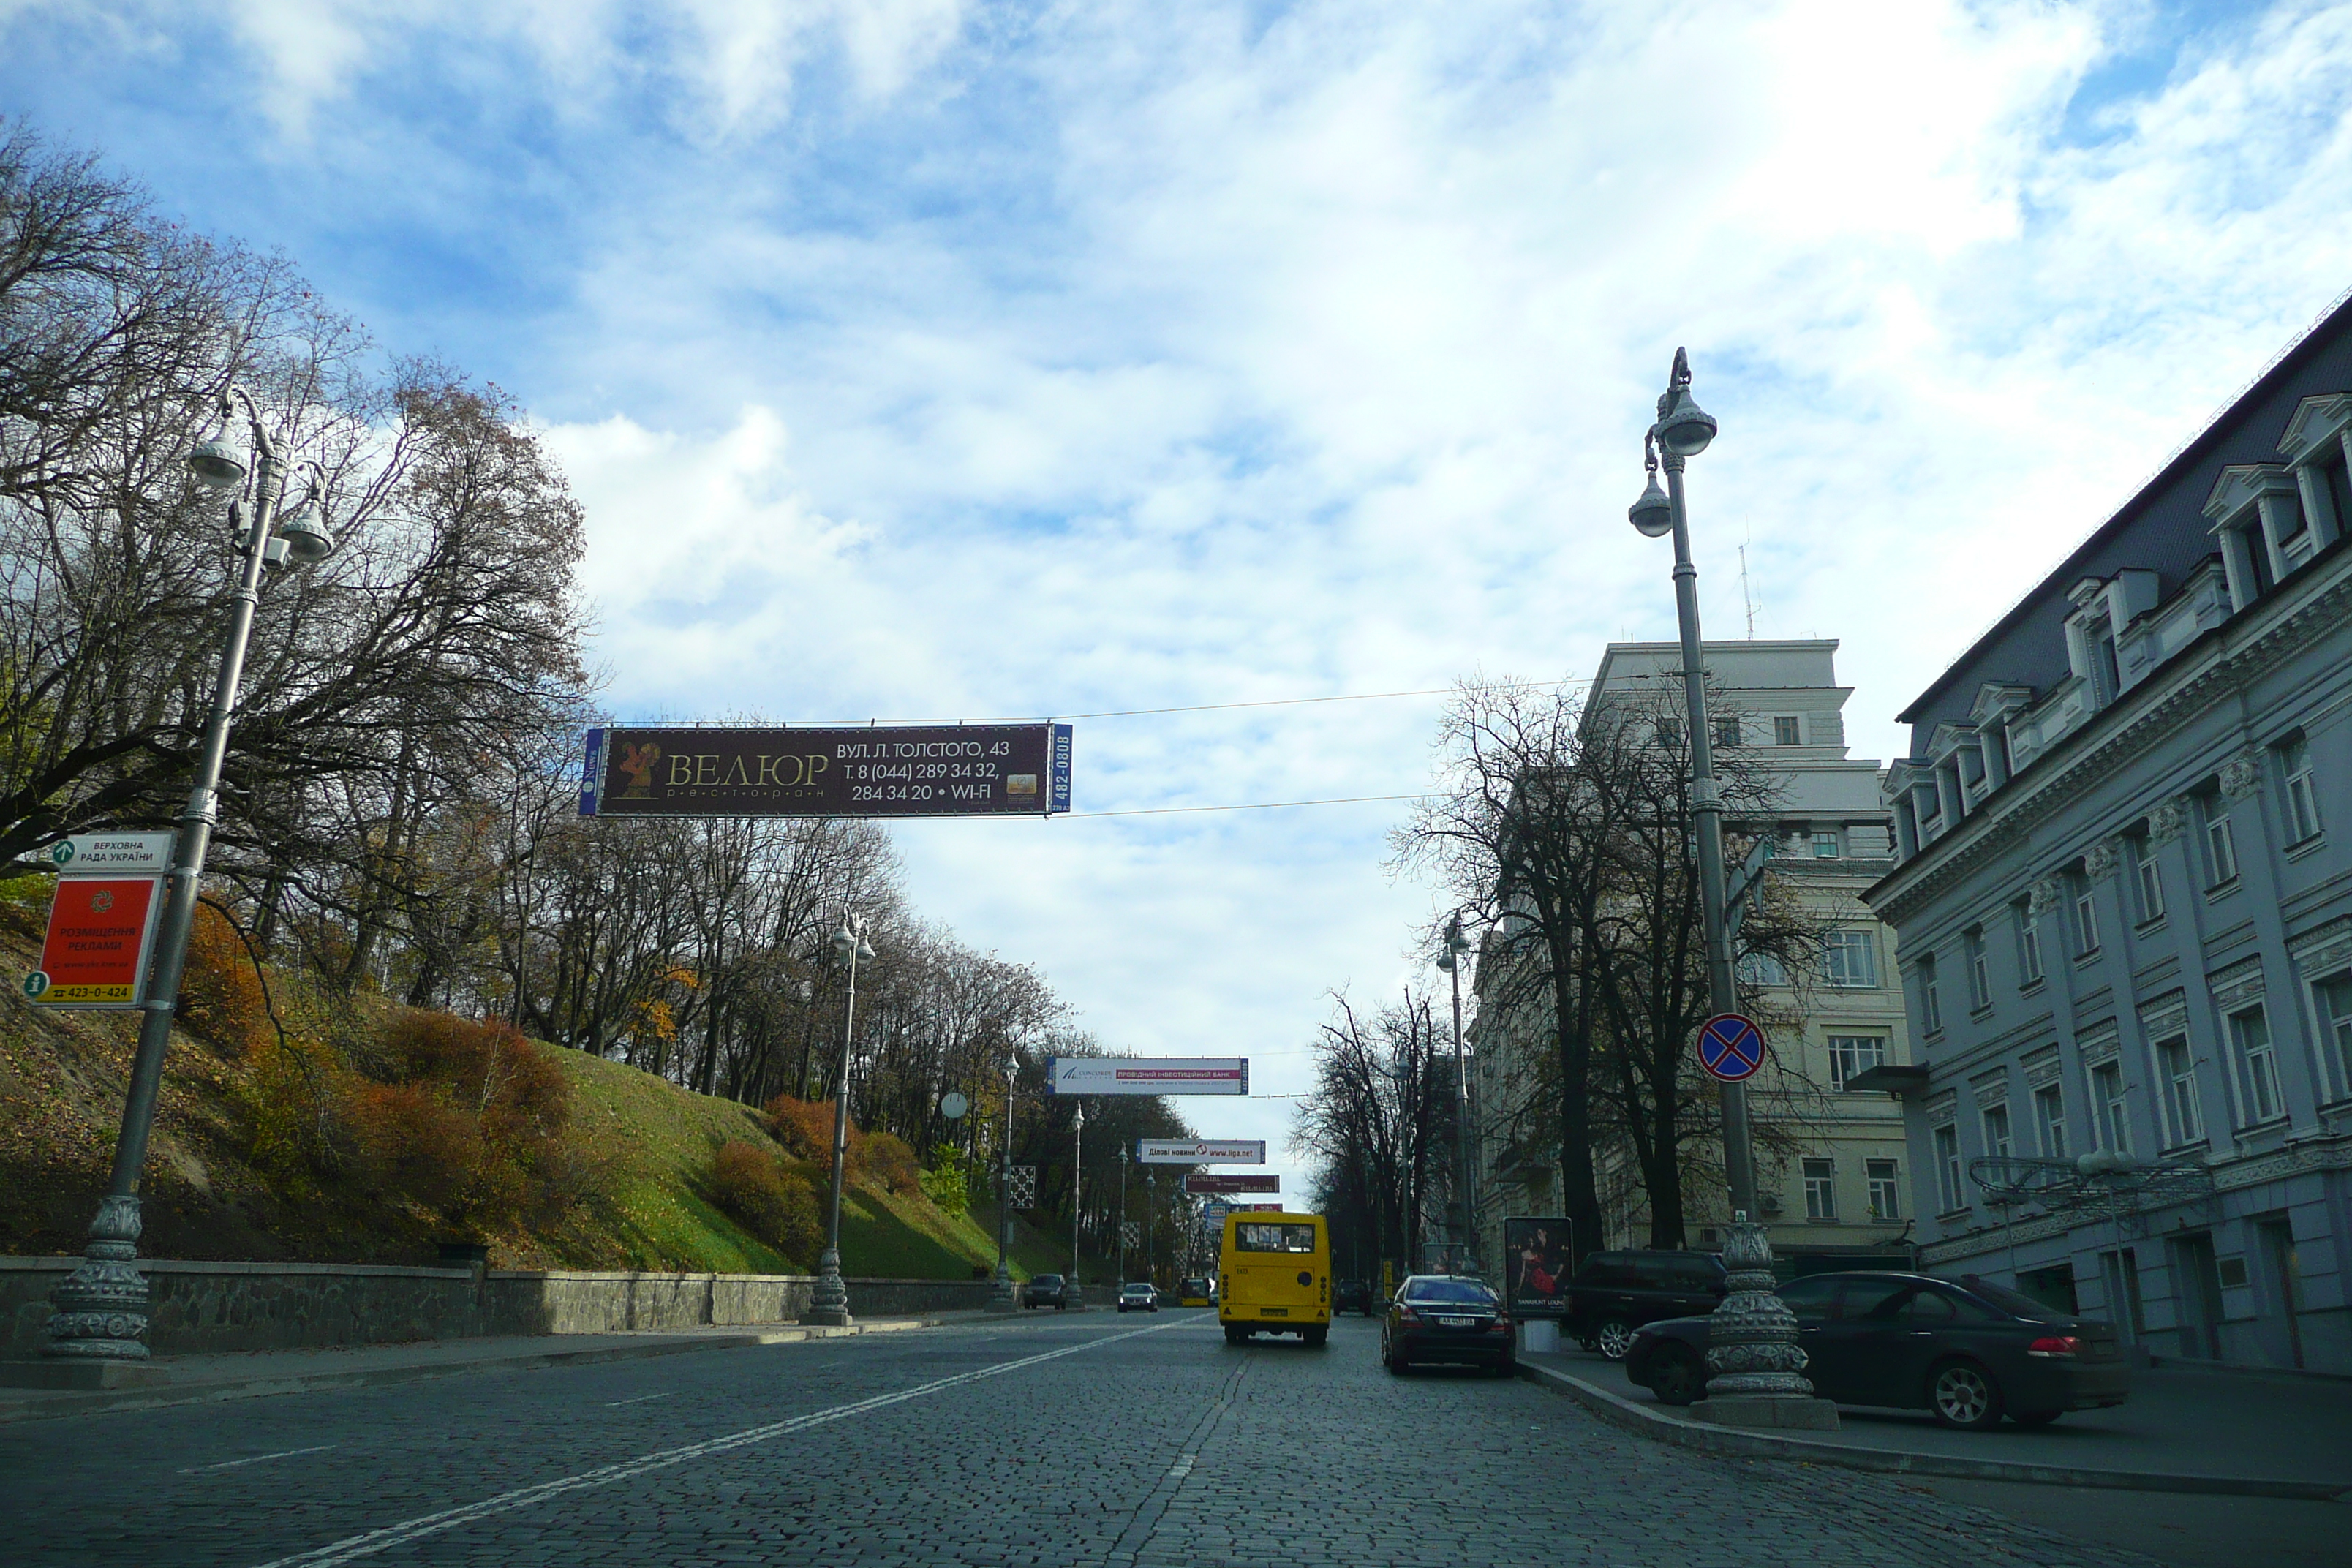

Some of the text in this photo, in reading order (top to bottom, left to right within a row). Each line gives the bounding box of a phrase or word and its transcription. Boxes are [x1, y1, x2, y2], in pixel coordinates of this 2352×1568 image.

[837, 741, 1009, 758] ВУЛ. Л. ТОЛСТОГО, 43
[665, 754, 829, 786] ВЕЛЮР
[858, 765, 868, 780] 8
[872, 763, 912, 783] (044)
[916, 764, 947, 779] 289
[951, 764, 972, 778] 34
[975, 763, 1000, 780] 32,
[1055, 736, 1069, 800] 482-0808
[851, 786, 883, 801] 284
[886, 786, 908, 800] 34
[911, 785, 932, 799] 20
[951, 785, 991, 799] WI-FI
[94, 842, 143, 850] ВЕРХОВНА
[80, 853, 153, 862] РАДА УКРАЇНИ
[60, 927, 136, 938] РОЗМІЩЕННЯ
[68, 941, 122, 951] РЕКЛАМИ
[67, 987, 128, 997] 423-0-424
[1149, 1147, 1170, 1156] Ділові
[1209, 1149, 1253, 1158] www.liga.net
